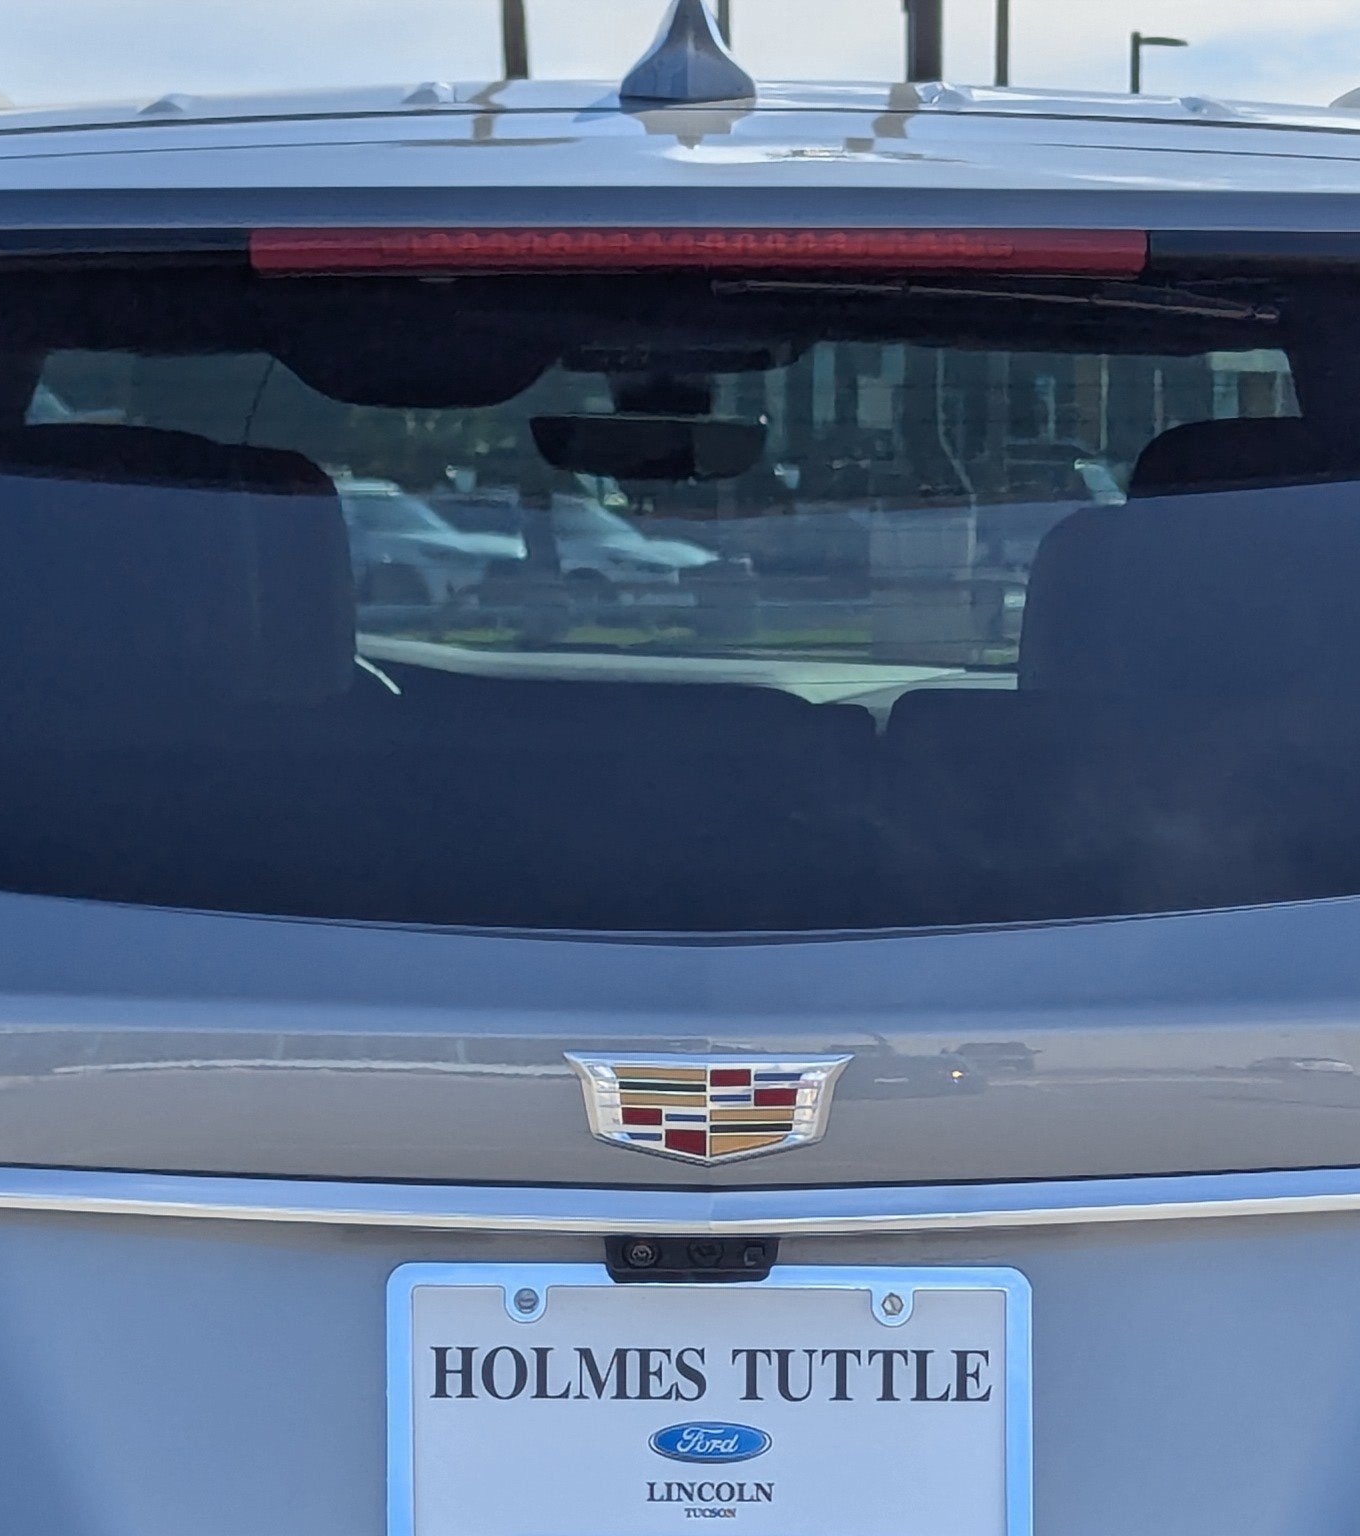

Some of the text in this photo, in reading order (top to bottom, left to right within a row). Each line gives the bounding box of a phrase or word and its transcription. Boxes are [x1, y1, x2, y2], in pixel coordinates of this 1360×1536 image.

[429, 1345, 993, 1402] HOLMES TUTTLE
[676, 1426, 739, 1453] Ford
[646, 1481, 775, 1503] LINCOLN
[685, 1507, 737, 1519] TUCSON
